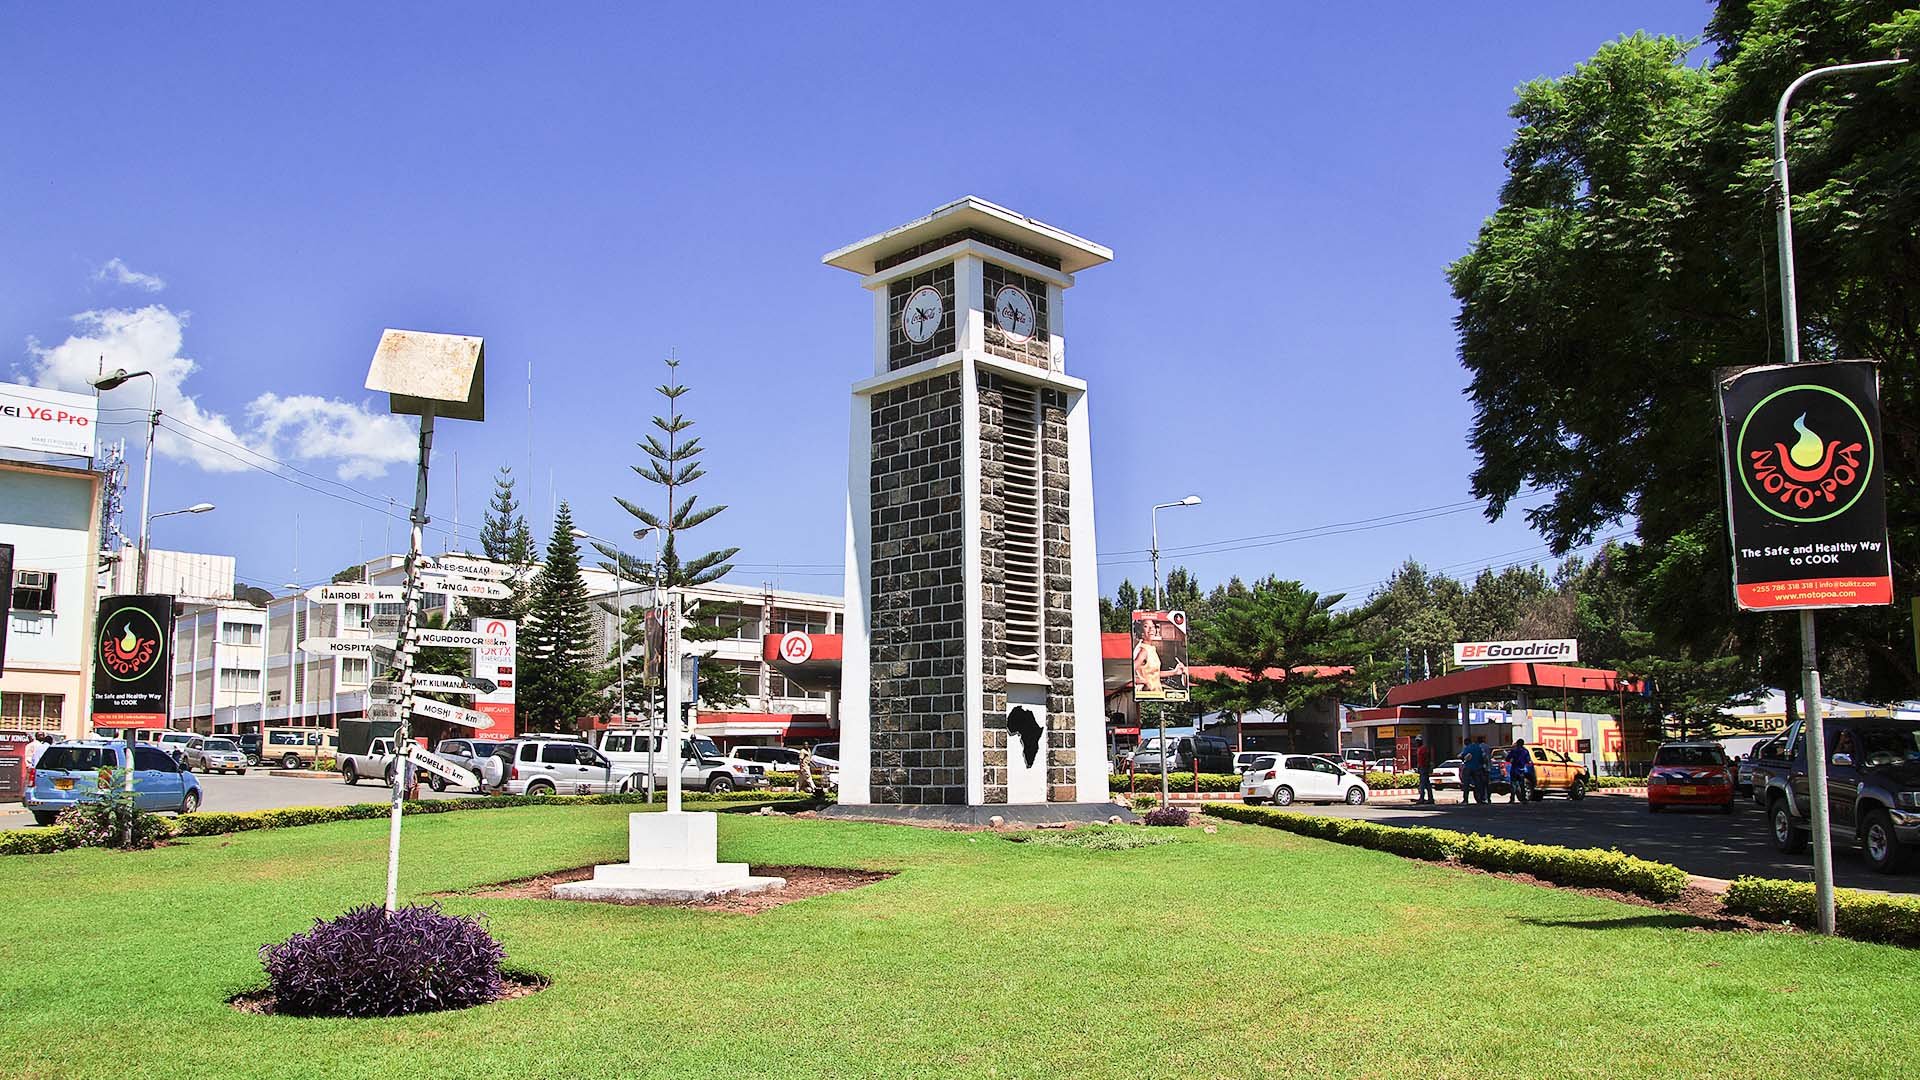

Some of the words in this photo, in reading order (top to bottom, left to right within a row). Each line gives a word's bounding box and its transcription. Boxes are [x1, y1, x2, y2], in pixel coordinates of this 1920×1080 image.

[26, 406, 53, 421] Y6
[57, 411, 89, 426] Pro
[1741, 548, 1761, 558] The
[1765, 545, 1790, 557] Safe
[1793, 544, 1813, 554] and
[1815, 542, 1857, 553] Healthy
[1860, 541, 1881, 552] Way
[1790, 557, 1803, 566] to
[1805, 554, 1840, 564] COOK
[321, 589, 360, 600] NAIROBI
[378, 591, 394, 599] km
[437, 582, 468, 592] TANGA
[487, 586, 500, 595] km
[1775, 590, 1857, 601] www.motopoa.com
[422, 634, 471, 644] NGURDOTO
[330, 643, 373, 652] HOSPITA
[1462, 642, 1570, 657] BFGoodrich
[126, 692, 147, 700] Healthy
[424, 705, 451, 717] MOSHI
[465, 713, 477, 724] km
[1396, 743, 1409, 751] OUT
[416, 753, 444, 772] MOMELA
[452, 769, 463, 781] km
